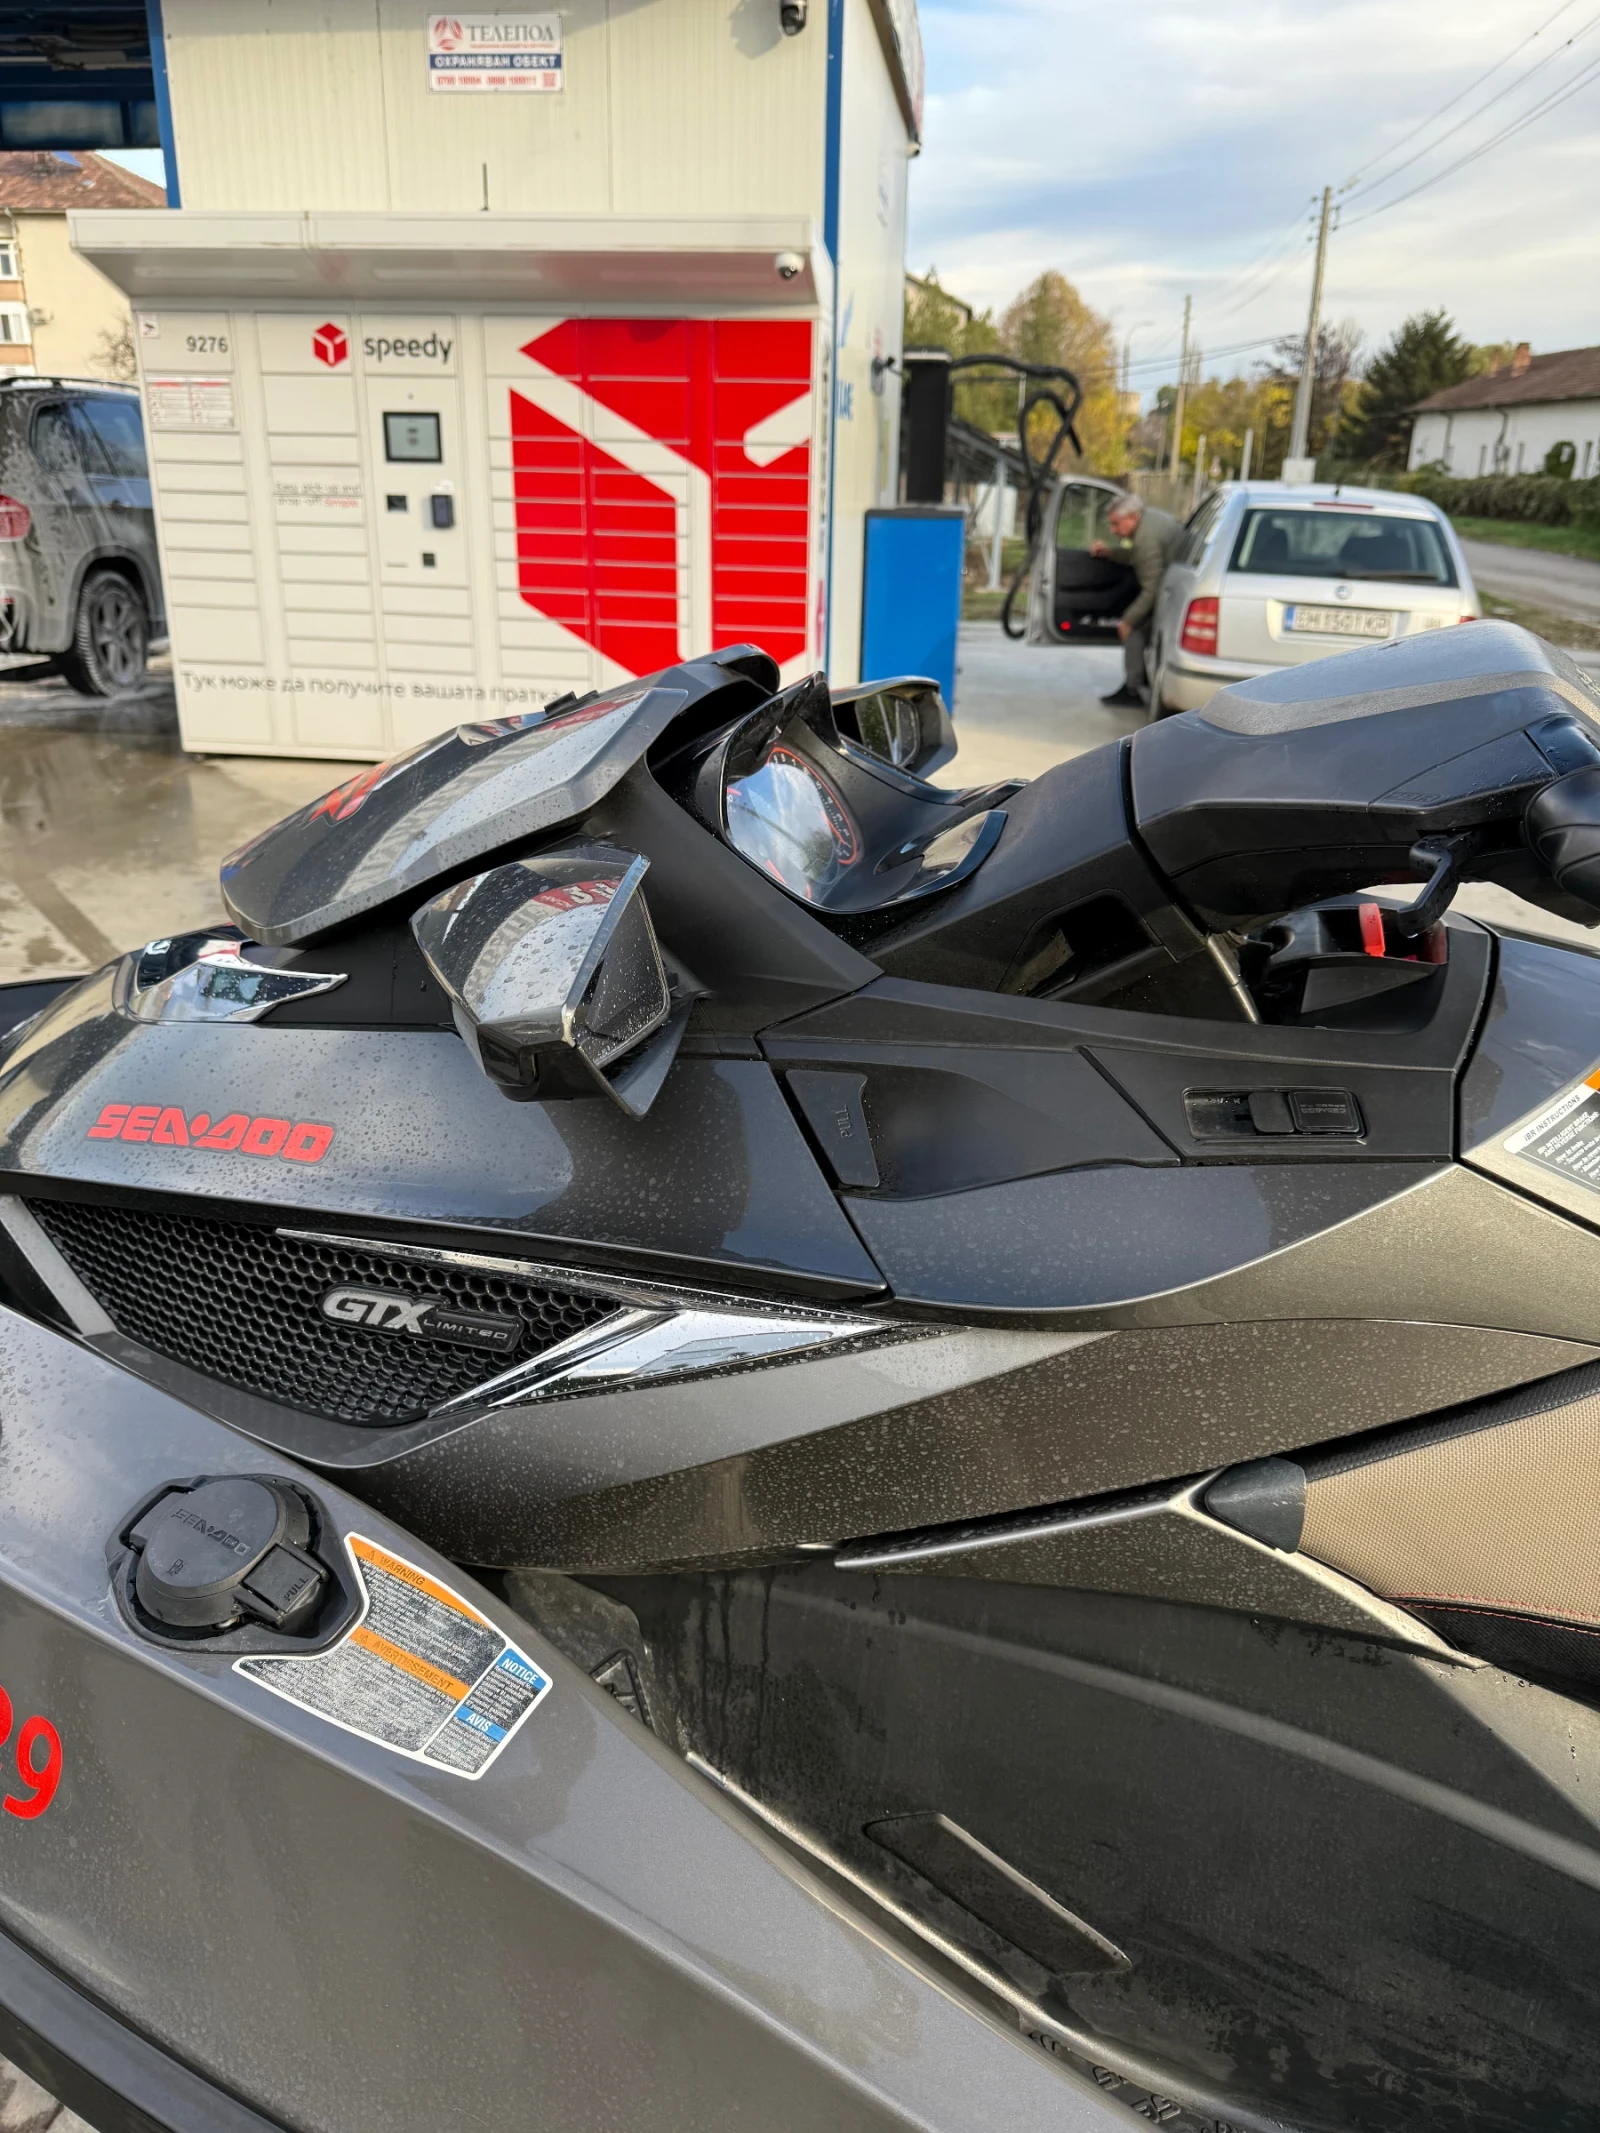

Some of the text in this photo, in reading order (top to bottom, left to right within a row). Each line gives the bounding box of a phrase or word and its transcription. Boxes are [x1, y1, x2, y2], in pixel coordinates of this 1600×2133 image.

[466, 25, 554, 42] ТЕЛЕПОЛ
[434, 56, 557, 68] ОХРАНЯВАН ОБЕКТ
[187, 335, 229, 354] 9276
[364, 331, 452, 365] speedy
[181, 671, 216, 692] Тук
[221, 674, 277, 692] може
[282, 676, 305, 693] да
[310, 678, 405, 699] получите
[412, 682, 486, 701] вашата
[1524, 1094, 1581, 1142] iBR INSTRUCTIONS
[323, 1287, 508, 1340] GTX LIMITED
[380, 1556, 426, 1586] WARNING
[283, 1578, 308, 1602] PULL
[371, 1640, 454, 1692] AVERTISSEMENT
[501, 1658, 539, 1685] NOTICE
[466, 1713, 491, 1732] AVIS
